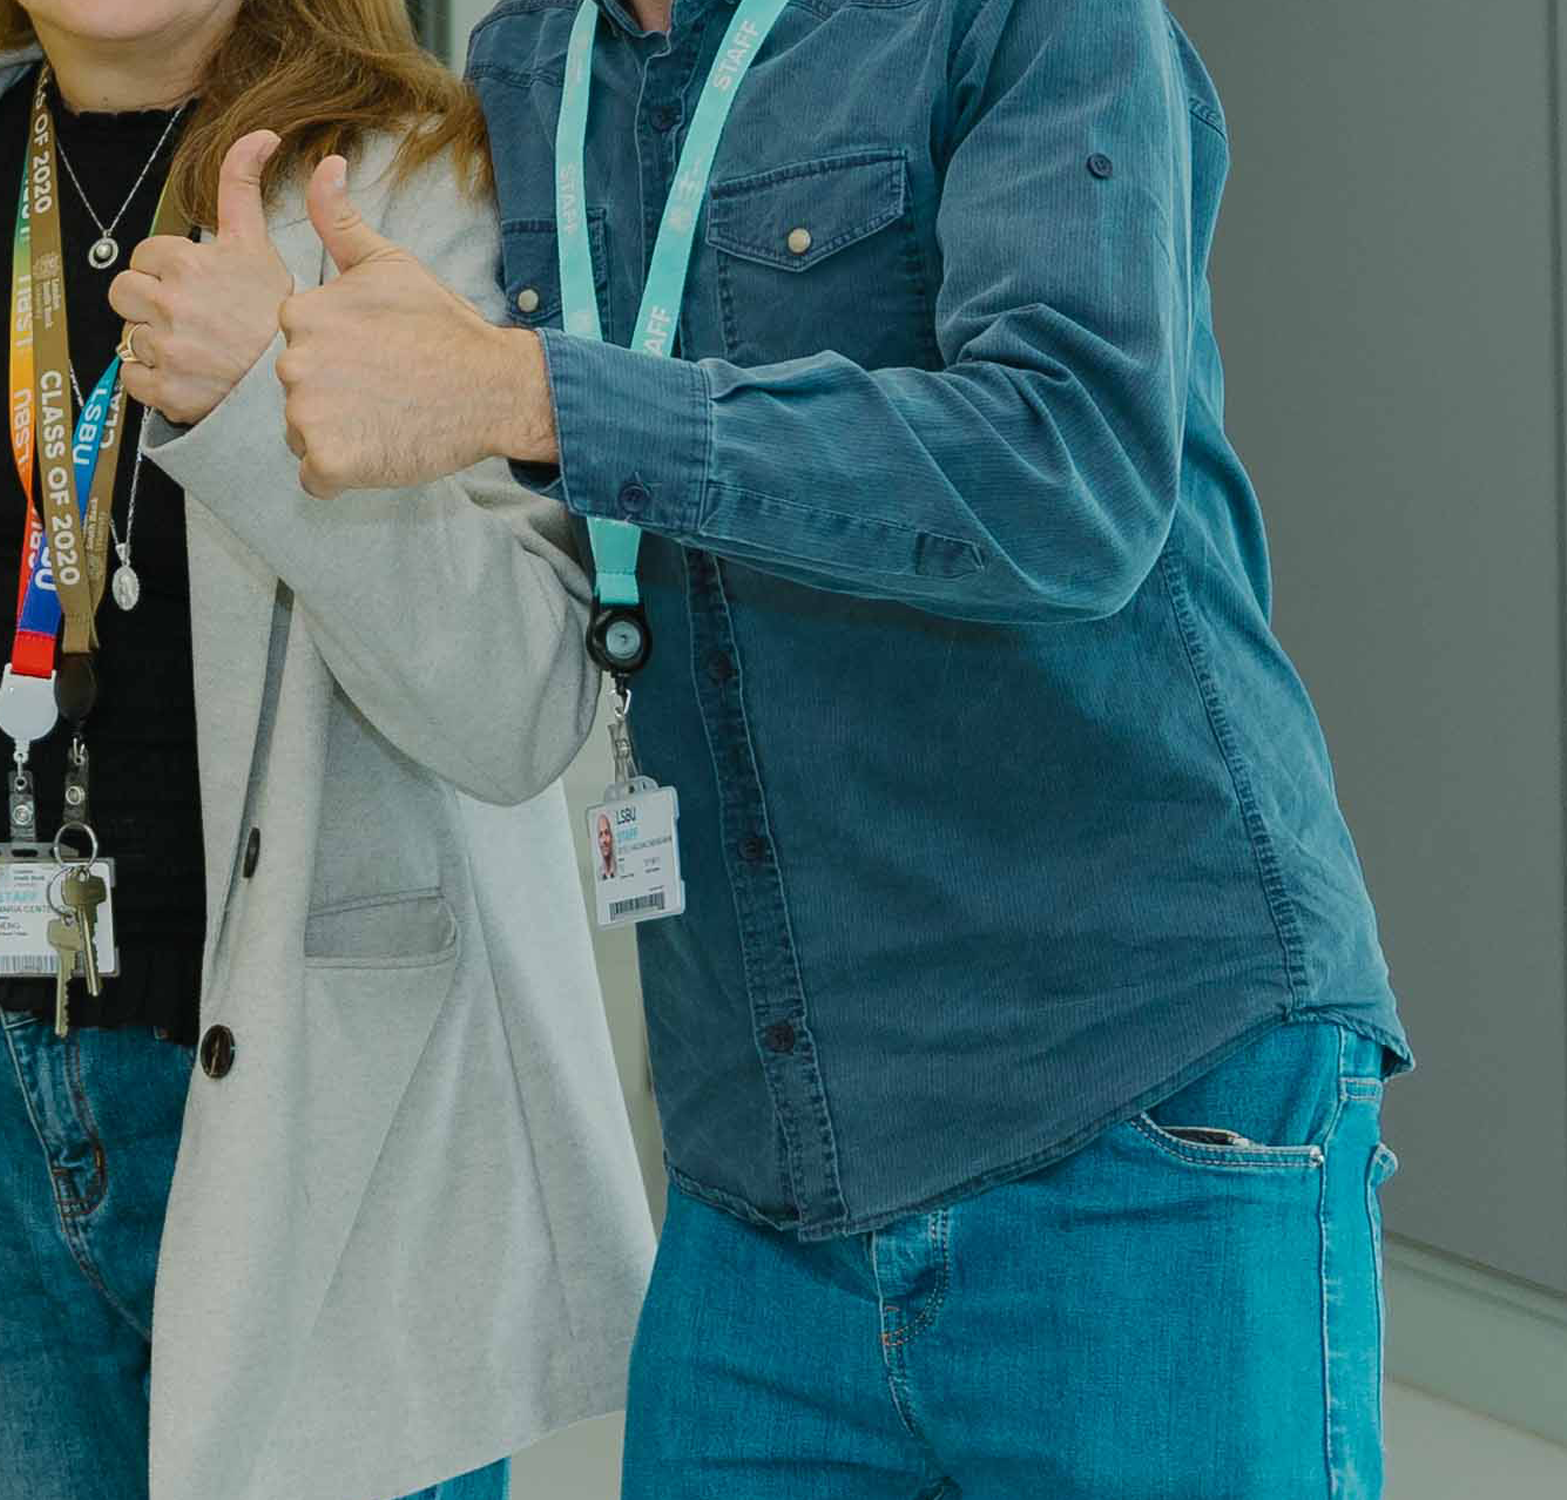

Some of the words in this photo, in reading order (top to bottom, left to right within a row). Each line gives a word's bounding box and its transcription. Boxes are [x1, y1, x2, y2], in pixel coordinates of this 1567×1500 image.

[712, 19, 759, 91] STAFF
[33, 113, 49, 146] OF
[33, 151, 53, 214] 2020
[642, 304, 671, 358] AFF
[40, 369, 66, 460] CLASS
[72, 386, 108, 466] LSBU
[47, 466, 70, 506] OF
[51, 513, 81, 586] 2020
[617, 807, 637, 825] LSBU
